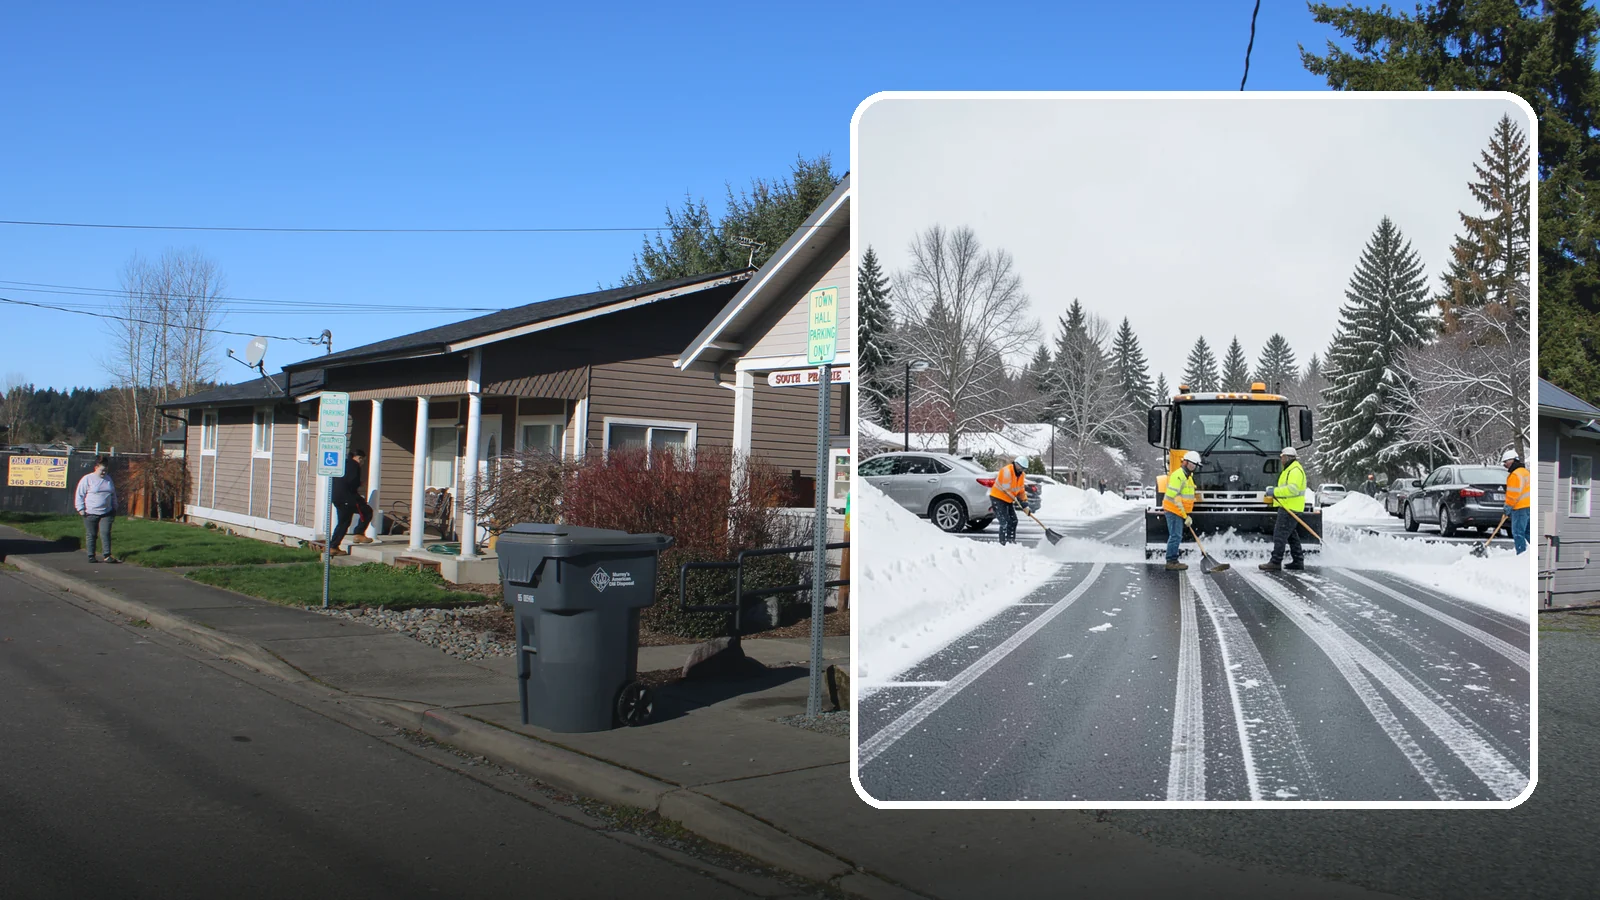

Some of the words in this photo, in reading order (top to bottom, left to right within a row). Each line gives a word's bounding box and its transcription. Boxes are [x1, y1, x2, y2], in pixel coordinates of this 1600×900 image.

[815, 295, 832, 308] TOWN
[814, 312, 831, 324] HALL
[810, 327, 835, 340] PARKING
[813, 344, 831, 357] ONLY
[776, 373, 800, 384] SOUTH
[808, 371, 841, 381] PRIE
